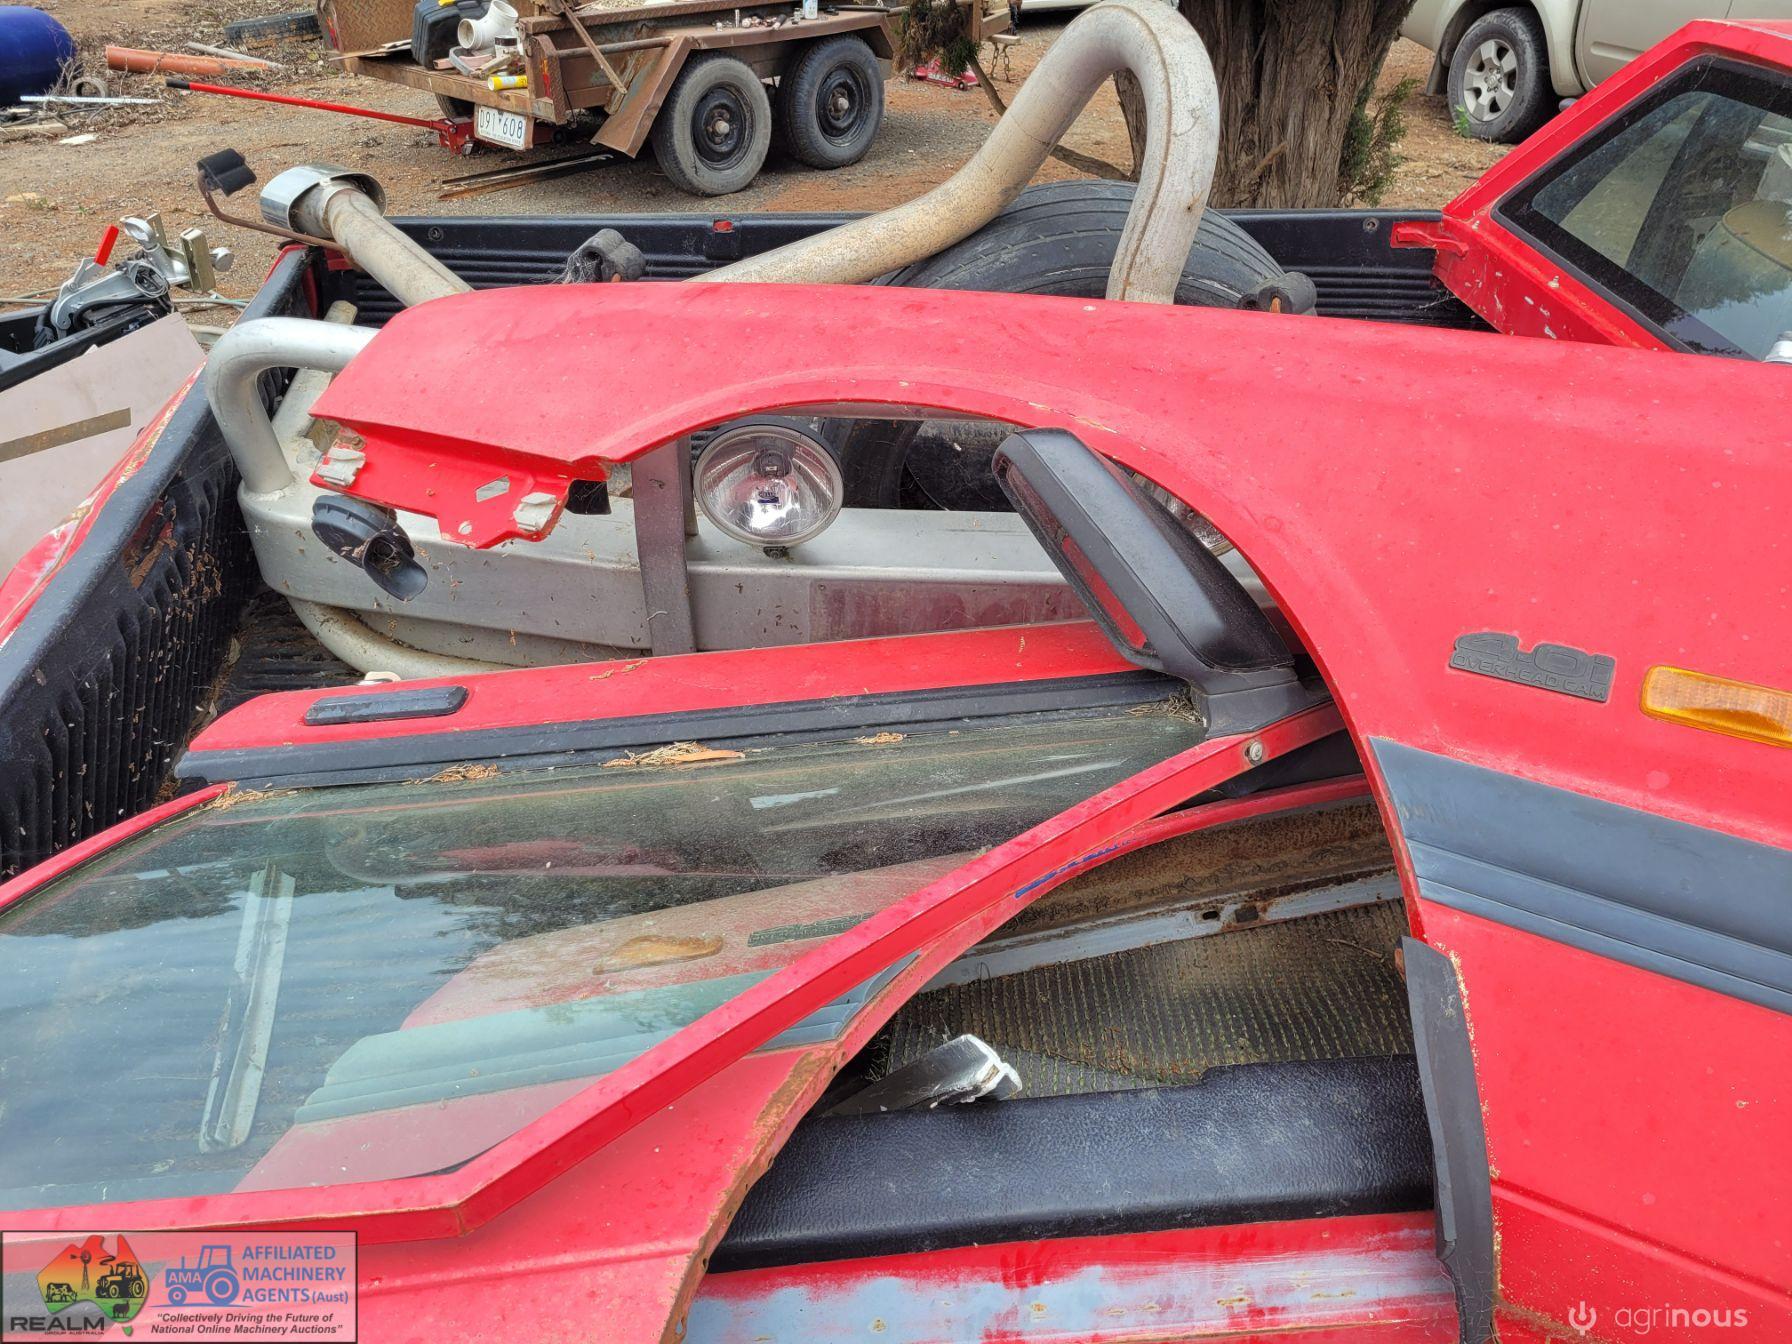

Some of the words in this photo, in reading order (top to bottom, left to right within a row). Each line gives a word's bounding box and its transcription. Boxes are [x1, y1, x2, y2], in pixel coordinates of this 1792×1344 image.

[502, 117, 523, 139] 608
[1452, 653, 1559, 688] OVERHEAD
[1562, 678, 1605, 700] CAM
